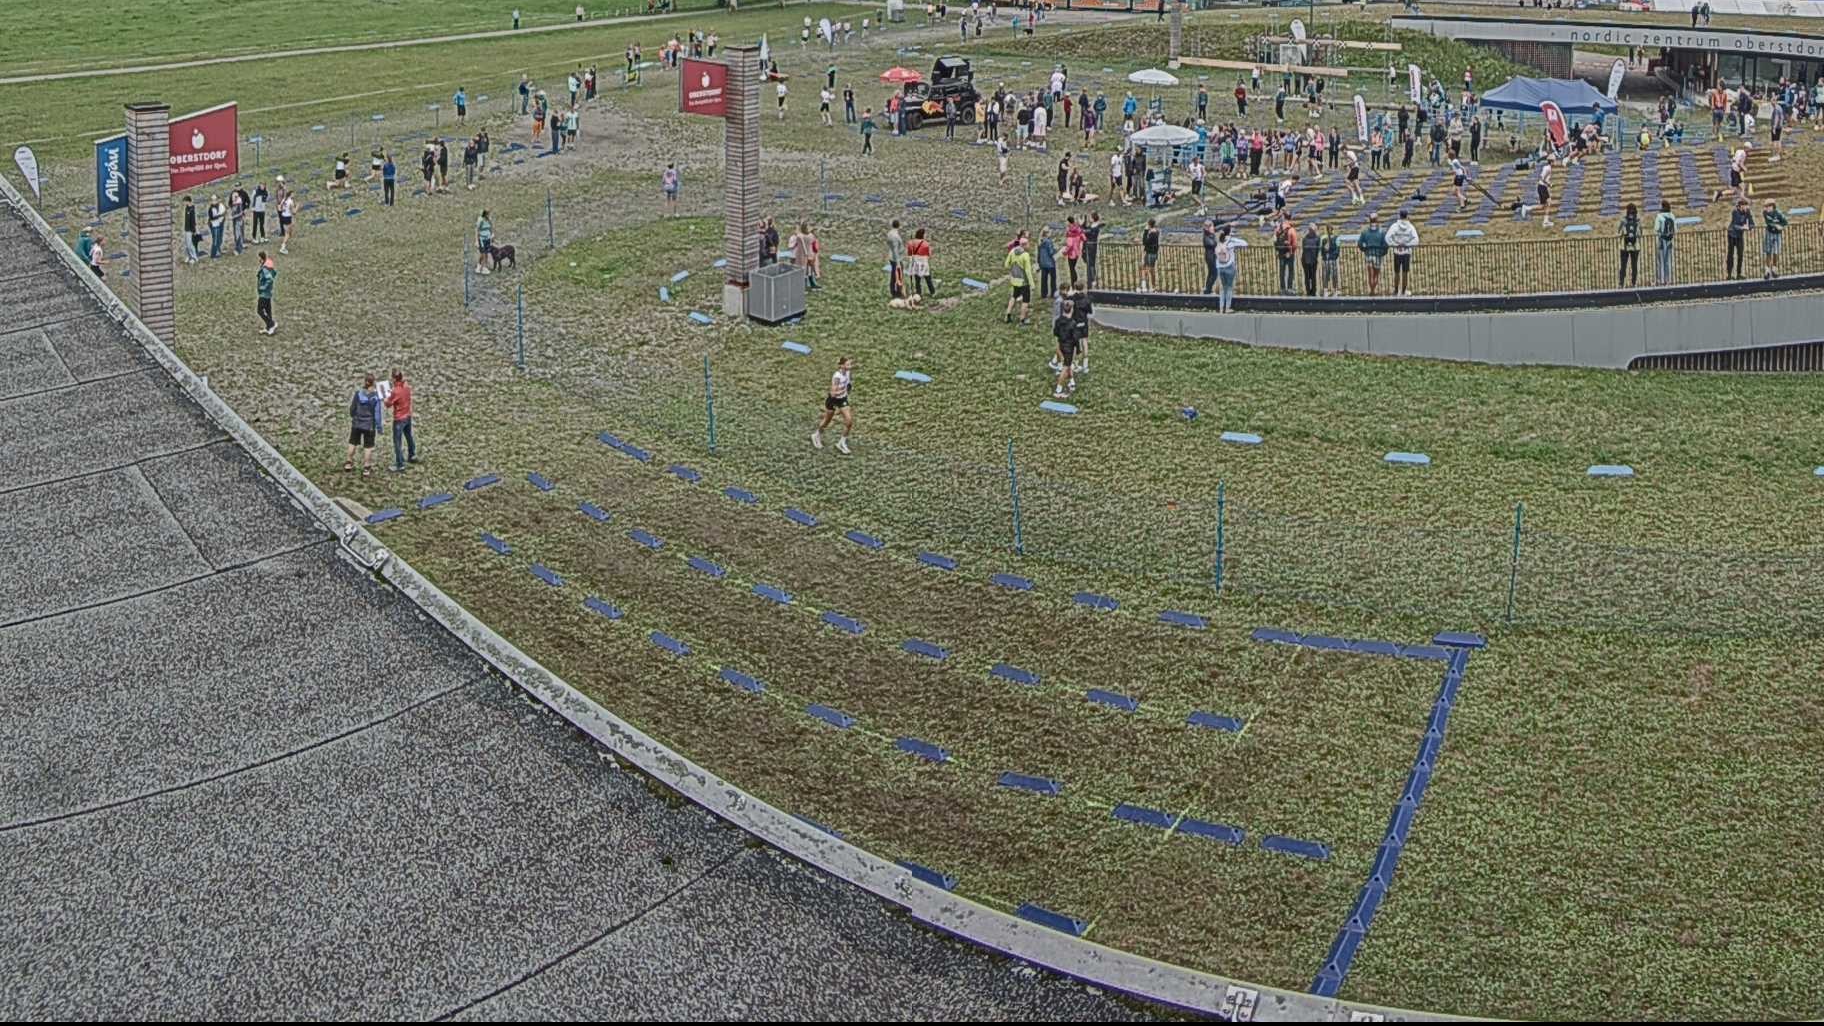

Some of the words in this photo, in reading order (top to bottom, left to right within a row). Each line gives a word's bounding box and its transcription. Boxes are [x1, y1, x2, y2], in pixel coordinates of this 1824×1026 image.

[1570, 30, 1631, 43] nordic
[1643, 35, 1720, 47] zentrum
[169, 150, 228, 165] OBERSTDORF
